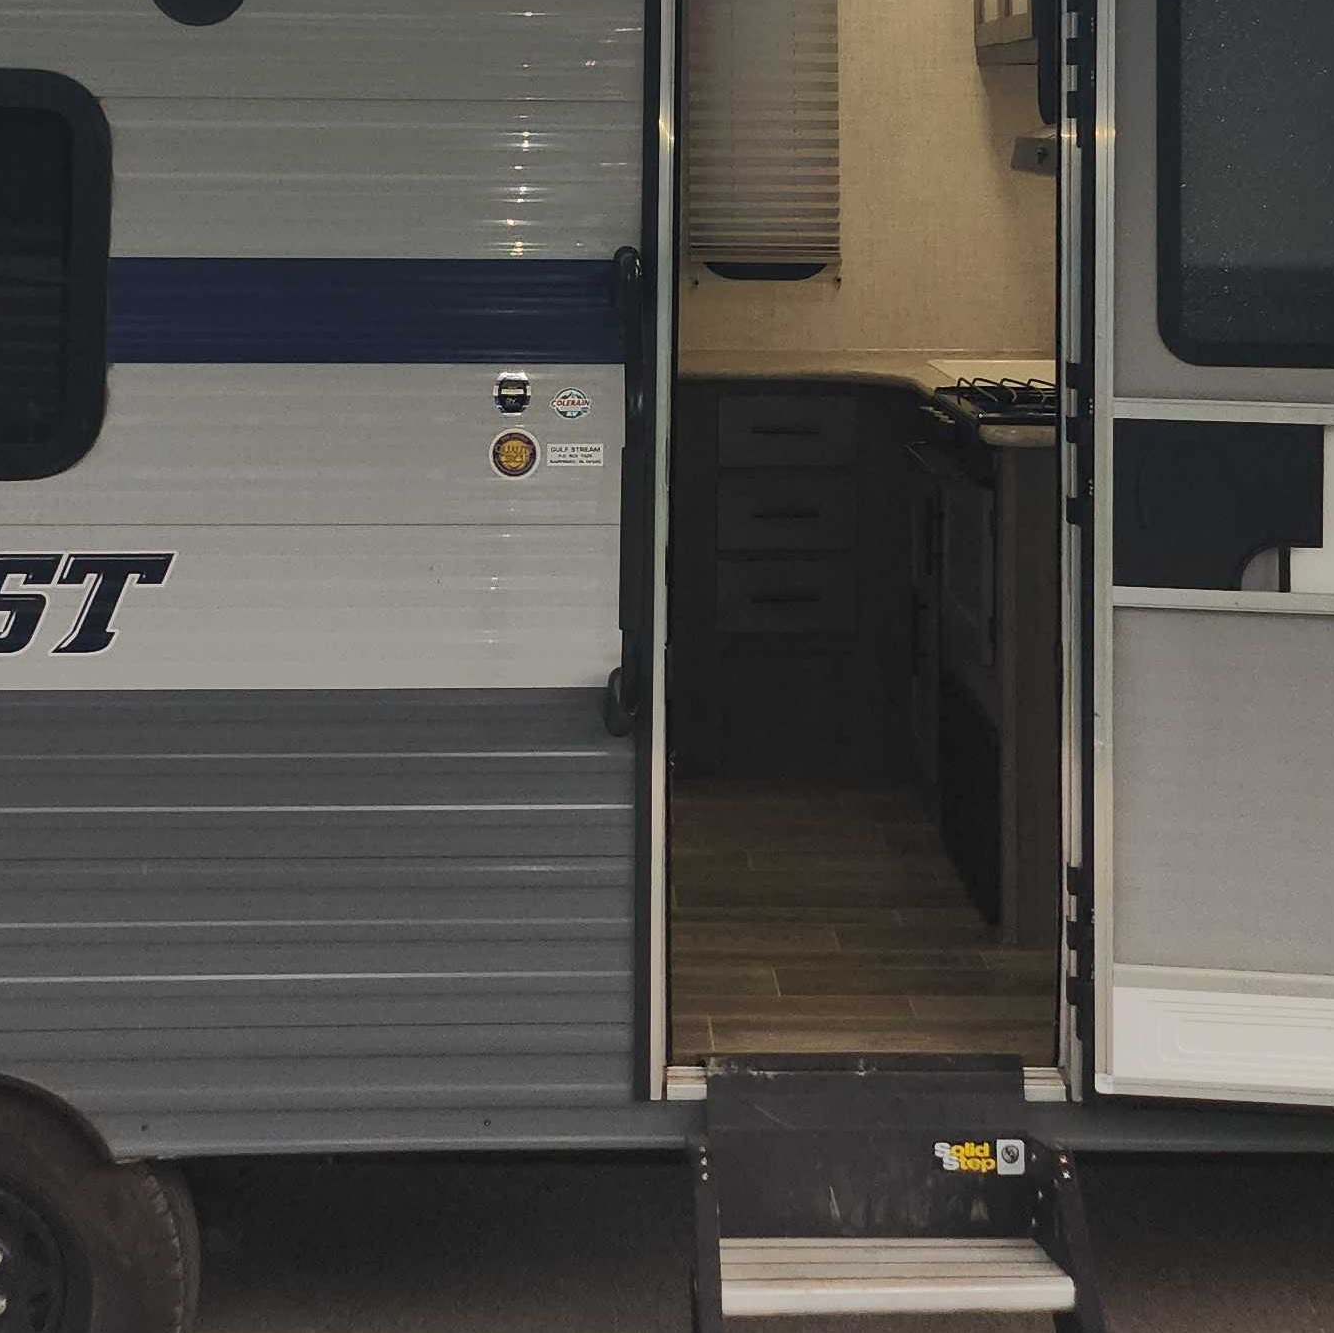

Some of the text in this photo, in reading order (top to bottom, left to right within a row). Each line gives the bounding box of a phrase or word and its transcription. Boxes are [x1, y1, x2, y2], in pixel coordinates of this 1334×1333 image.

[551, 399, 590, 407] COLERAIN
[934, 1141, 990, 1157] Solid
[942, 1155, 996, 1173] Step
